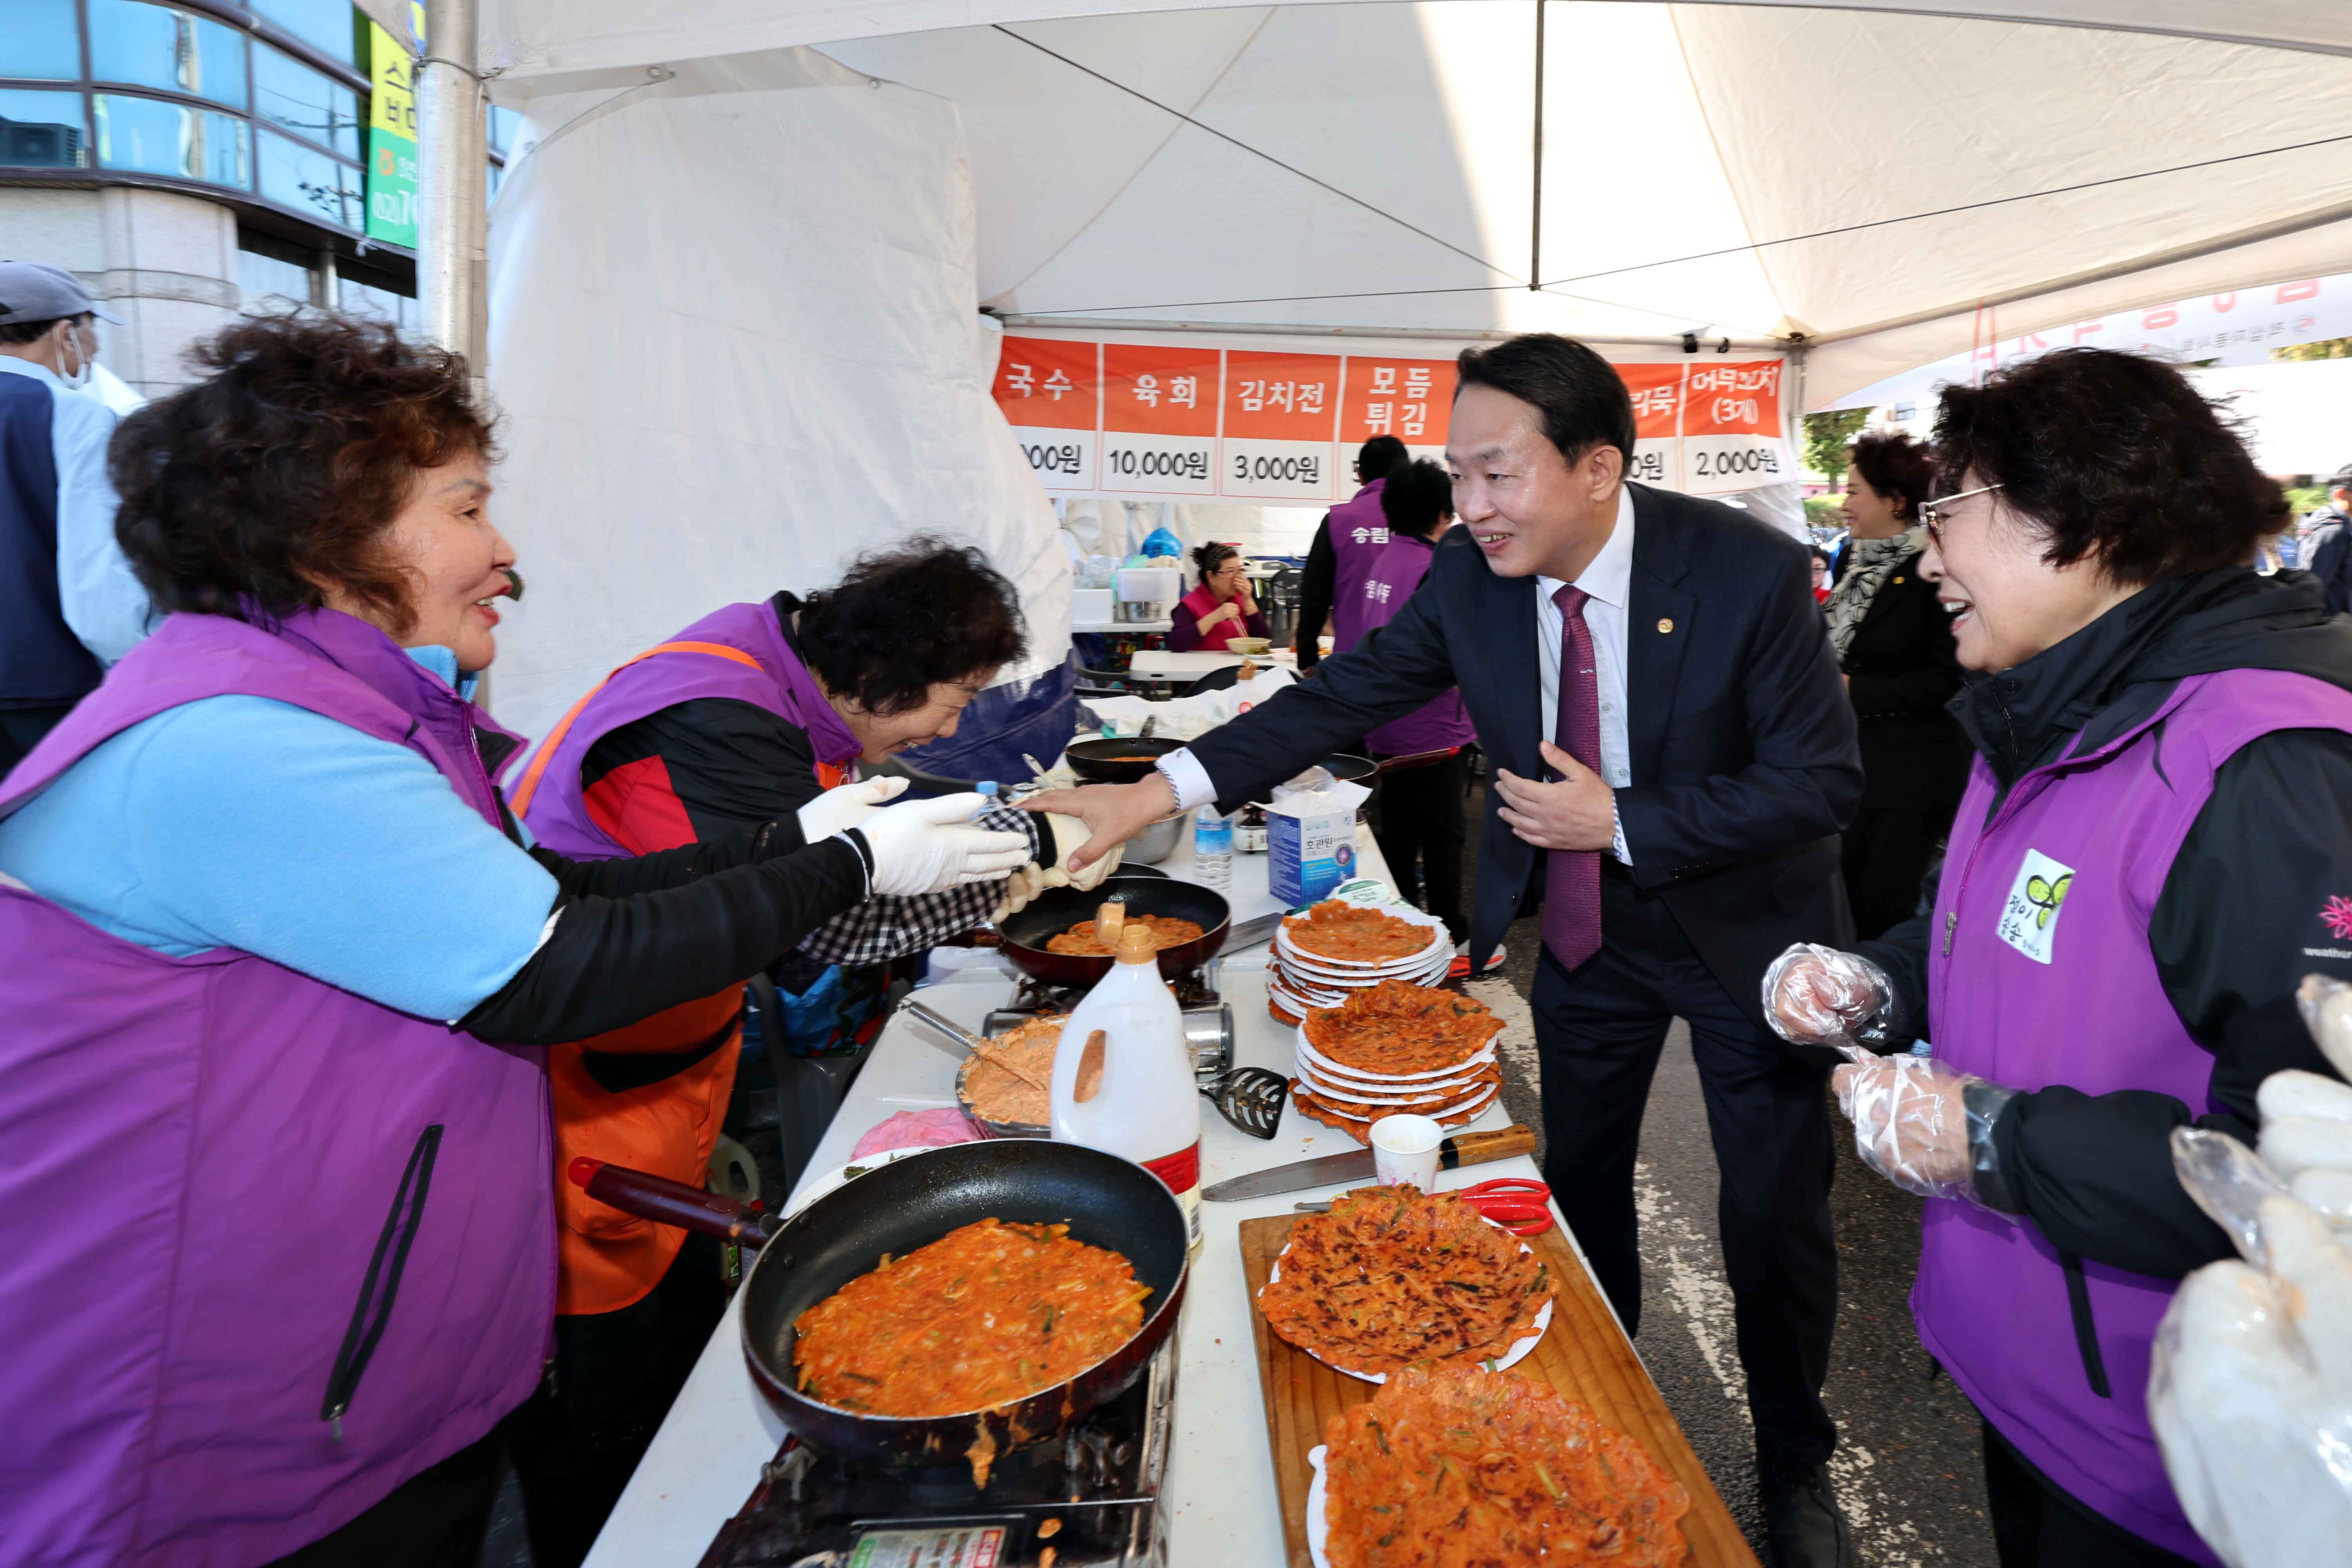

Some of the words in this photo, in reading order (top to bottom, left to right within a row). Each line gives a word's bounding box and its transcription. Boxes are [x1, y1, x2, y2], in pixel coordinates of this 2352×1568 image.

[1132, 374, 1197, 408] 육회
[1238, 379, 1325, 414] 김치전
[1711, 397, 1759, 425] (3개)
[1109, 449, 1208, 480] 10,000원
[1234, 455, 1320, 483] 3,000원
[1696, 448, 1780, 480] 2,000원
[1306, 837, 1332, 850] 호관원
